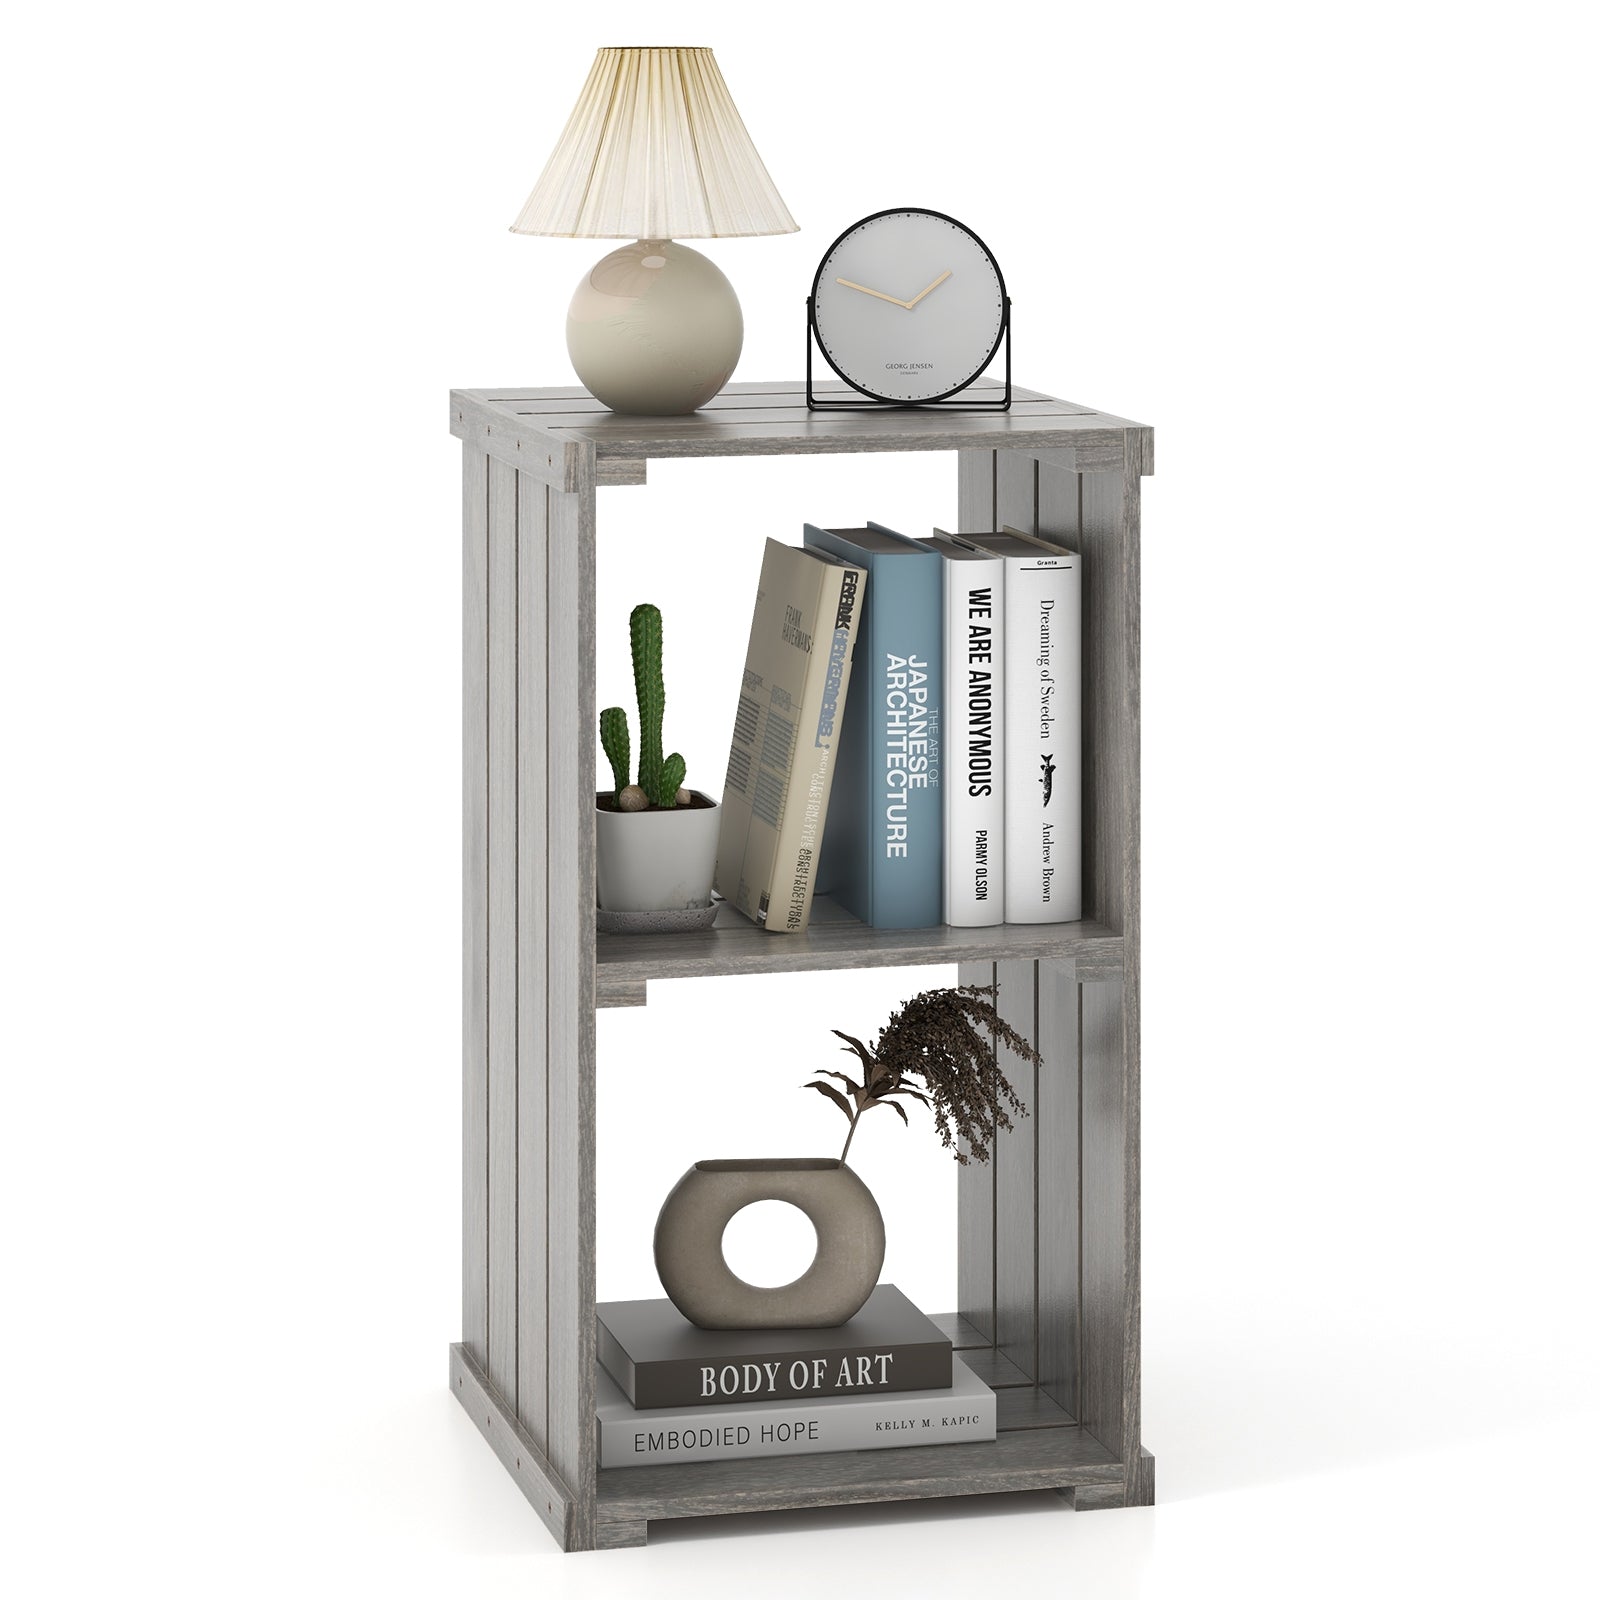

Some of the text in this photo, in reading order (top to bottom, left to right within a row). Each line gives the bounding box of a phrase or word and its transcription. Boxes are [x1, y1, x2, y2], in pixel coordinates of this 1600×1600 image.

[968, 587, 992, 797] WE ARE ANONYMOUS
[1036, 600, 1055, 739] Dreaming of Sweden
[886, 653, 908, 858] ARCHITECTURE
[908, 654, 928, 789] JAPANESE
[928, 707, 938, 787] THE ART OF
[786, 848, 806, 929] CONSTRUCTIONS
[793, 849, 812, 930] ARCHITECTURAL
[975, 830, 988, 901] PARMY OLSON
[1042, 822, 1055, 903] Andrew Brown
[700, 1353, 894, 1397] BODY OF ART
[634, 1421, 819, 1453] EMBODIED HOPE
[875, 1415, 980, 1431] KELLY M. KAPIC
